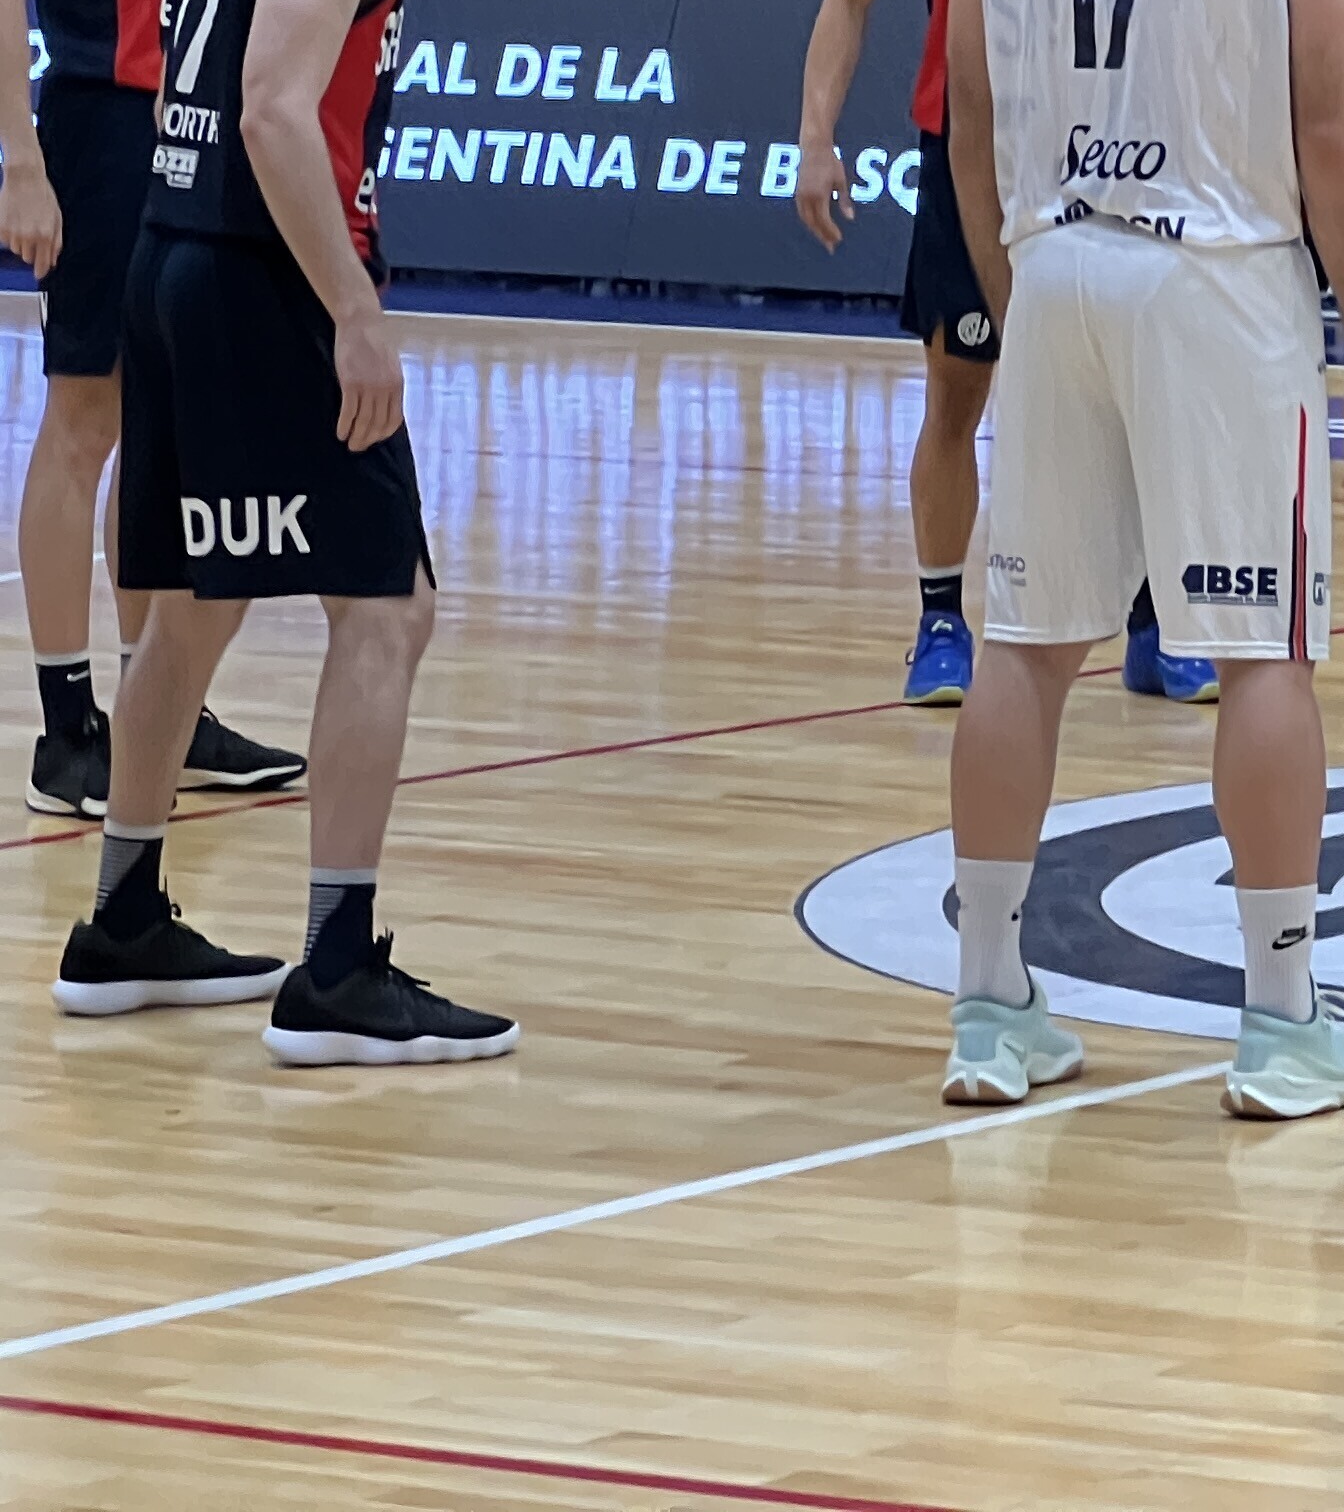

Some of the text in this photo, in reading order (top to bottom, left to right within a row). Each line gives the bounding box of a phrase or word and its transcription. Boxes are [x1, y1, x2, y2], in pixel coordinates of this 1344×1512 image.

[495, 42, 583, 101] DE
[594, 46, 676, 104] LA
[657, 137, 748, 196] DE
[1060, 123, 1167, 186] Secco
[181, 494, 311, 558] DUK
[1206, 564, 1278, 596] BSE
